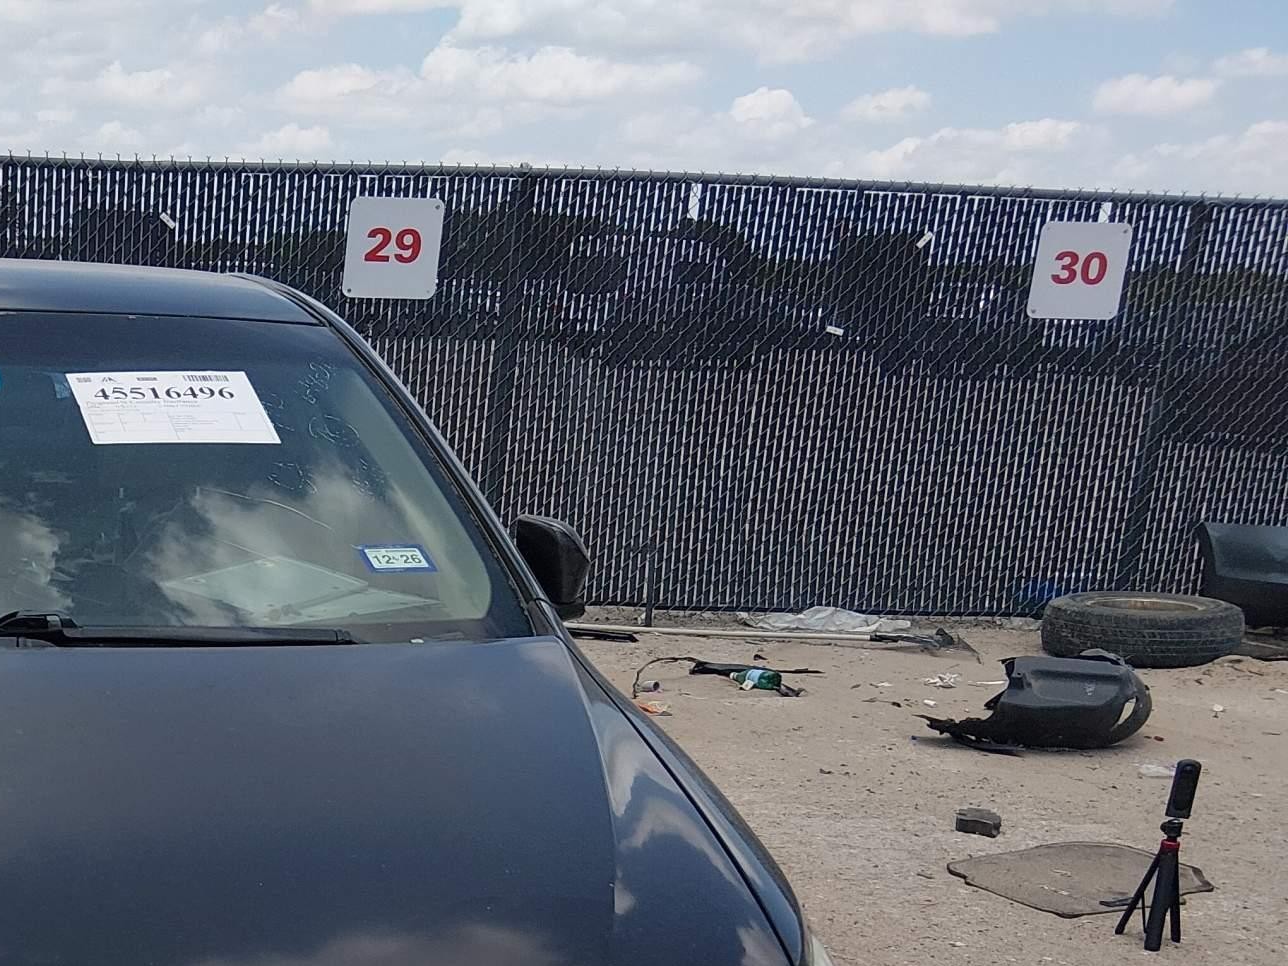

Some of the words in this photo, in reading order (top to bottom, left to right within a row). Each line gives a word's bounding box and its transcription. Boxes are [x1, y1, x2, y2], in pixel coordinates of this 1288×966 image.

[364, 228, 422, 262] 29
[1051, 251, 1108, 284] 30
[94, 386, 235, 400] 45516496
[372, 554, 395, 564] 12
[400, 553, 422, 564] 26
